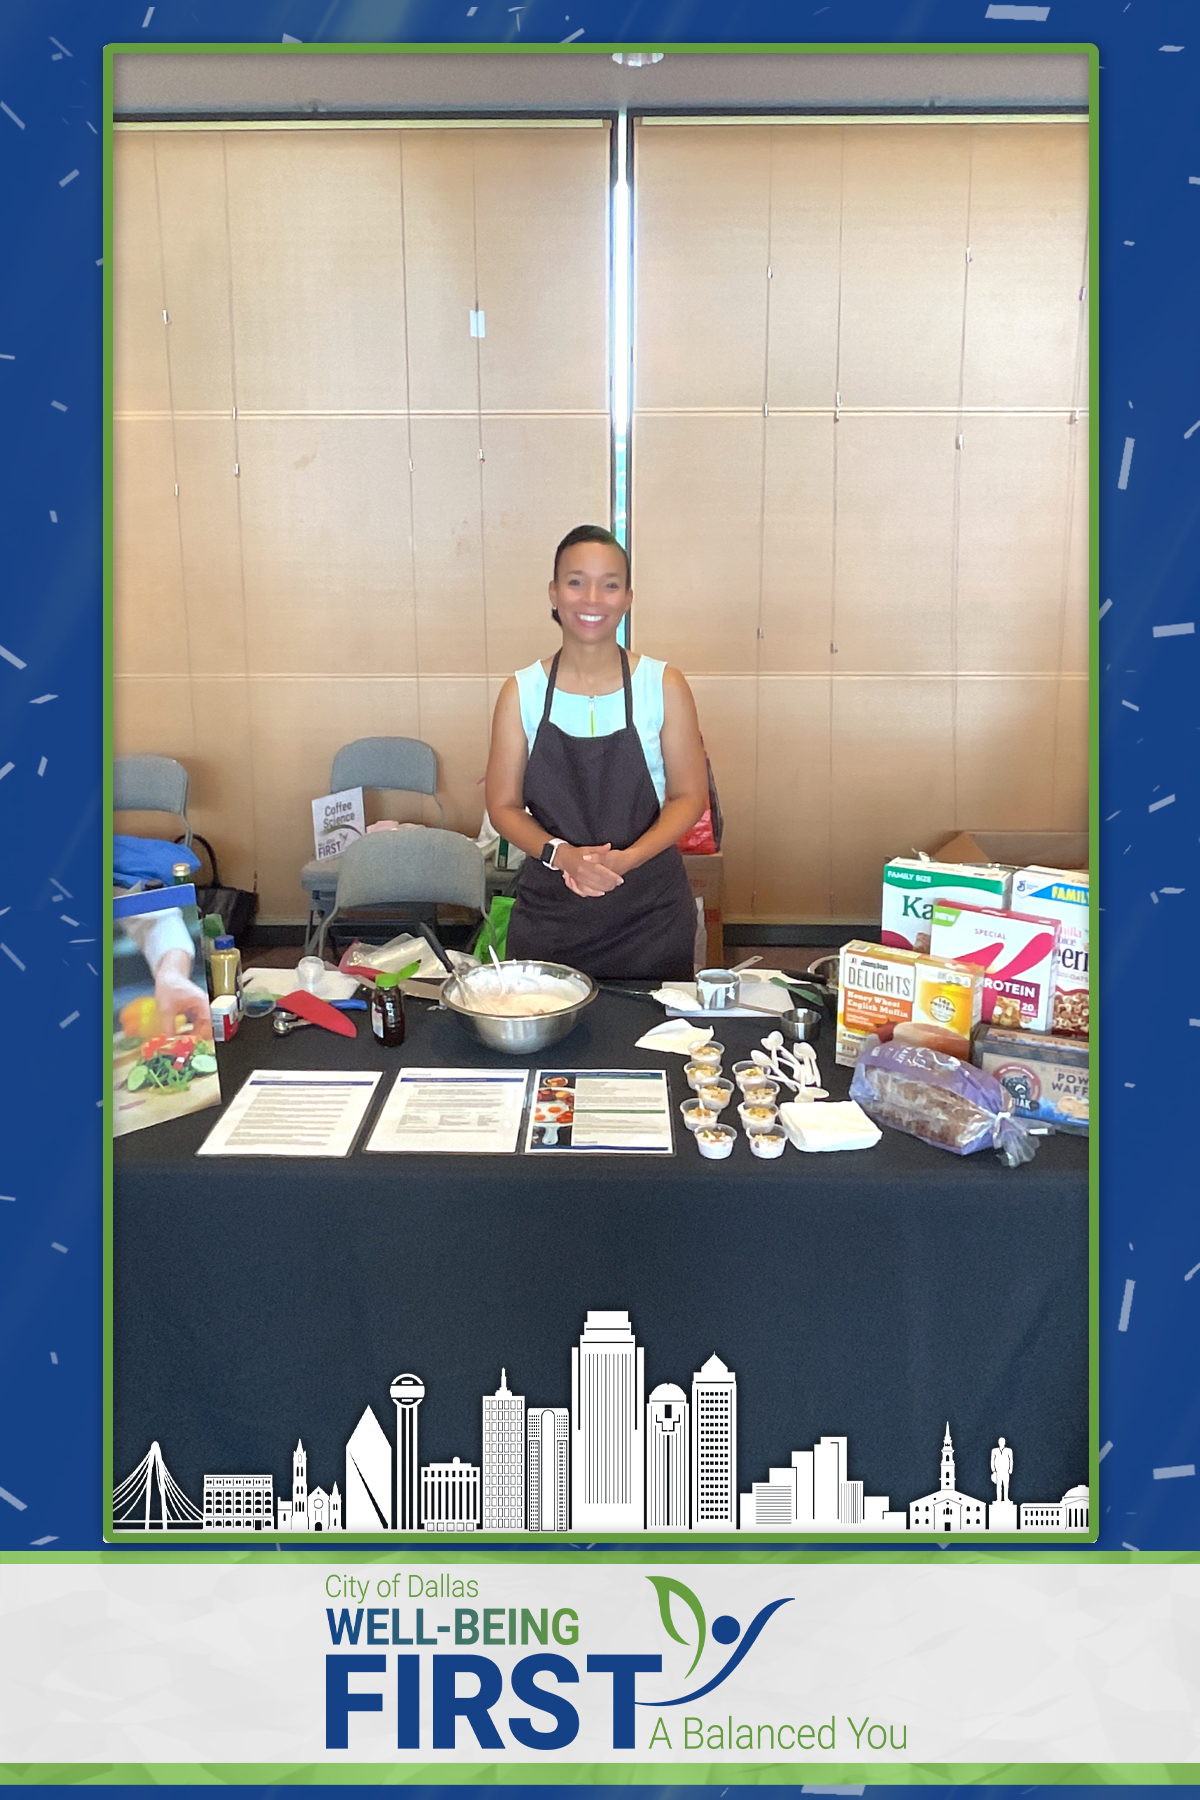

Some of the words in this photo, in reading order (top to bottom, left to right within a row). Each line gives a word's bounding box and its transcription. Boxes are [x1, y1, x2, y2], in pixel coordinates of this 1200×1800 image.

[324, 801, 353, 817] Coffee
[323, 811, 356, 829] Science
[318, 840, 341, 858] FIRST
[887, 870, 914, 881] FAMILY
[915, 874, 932, 883] SIZE
[935, 912, 956, 922] NEW
[974, 928, 1006, 940] SPECIAL
[848, 966, 911, 997] DELIGHTS
[847, 990, 873, 1004] Honey
[873, 996, 900, 1008] Wheat
[1021, 1002, 1034, 1012] 20
[847, 999, 877, 1012] English
[879, 1006, 908, 1018] Muffin
